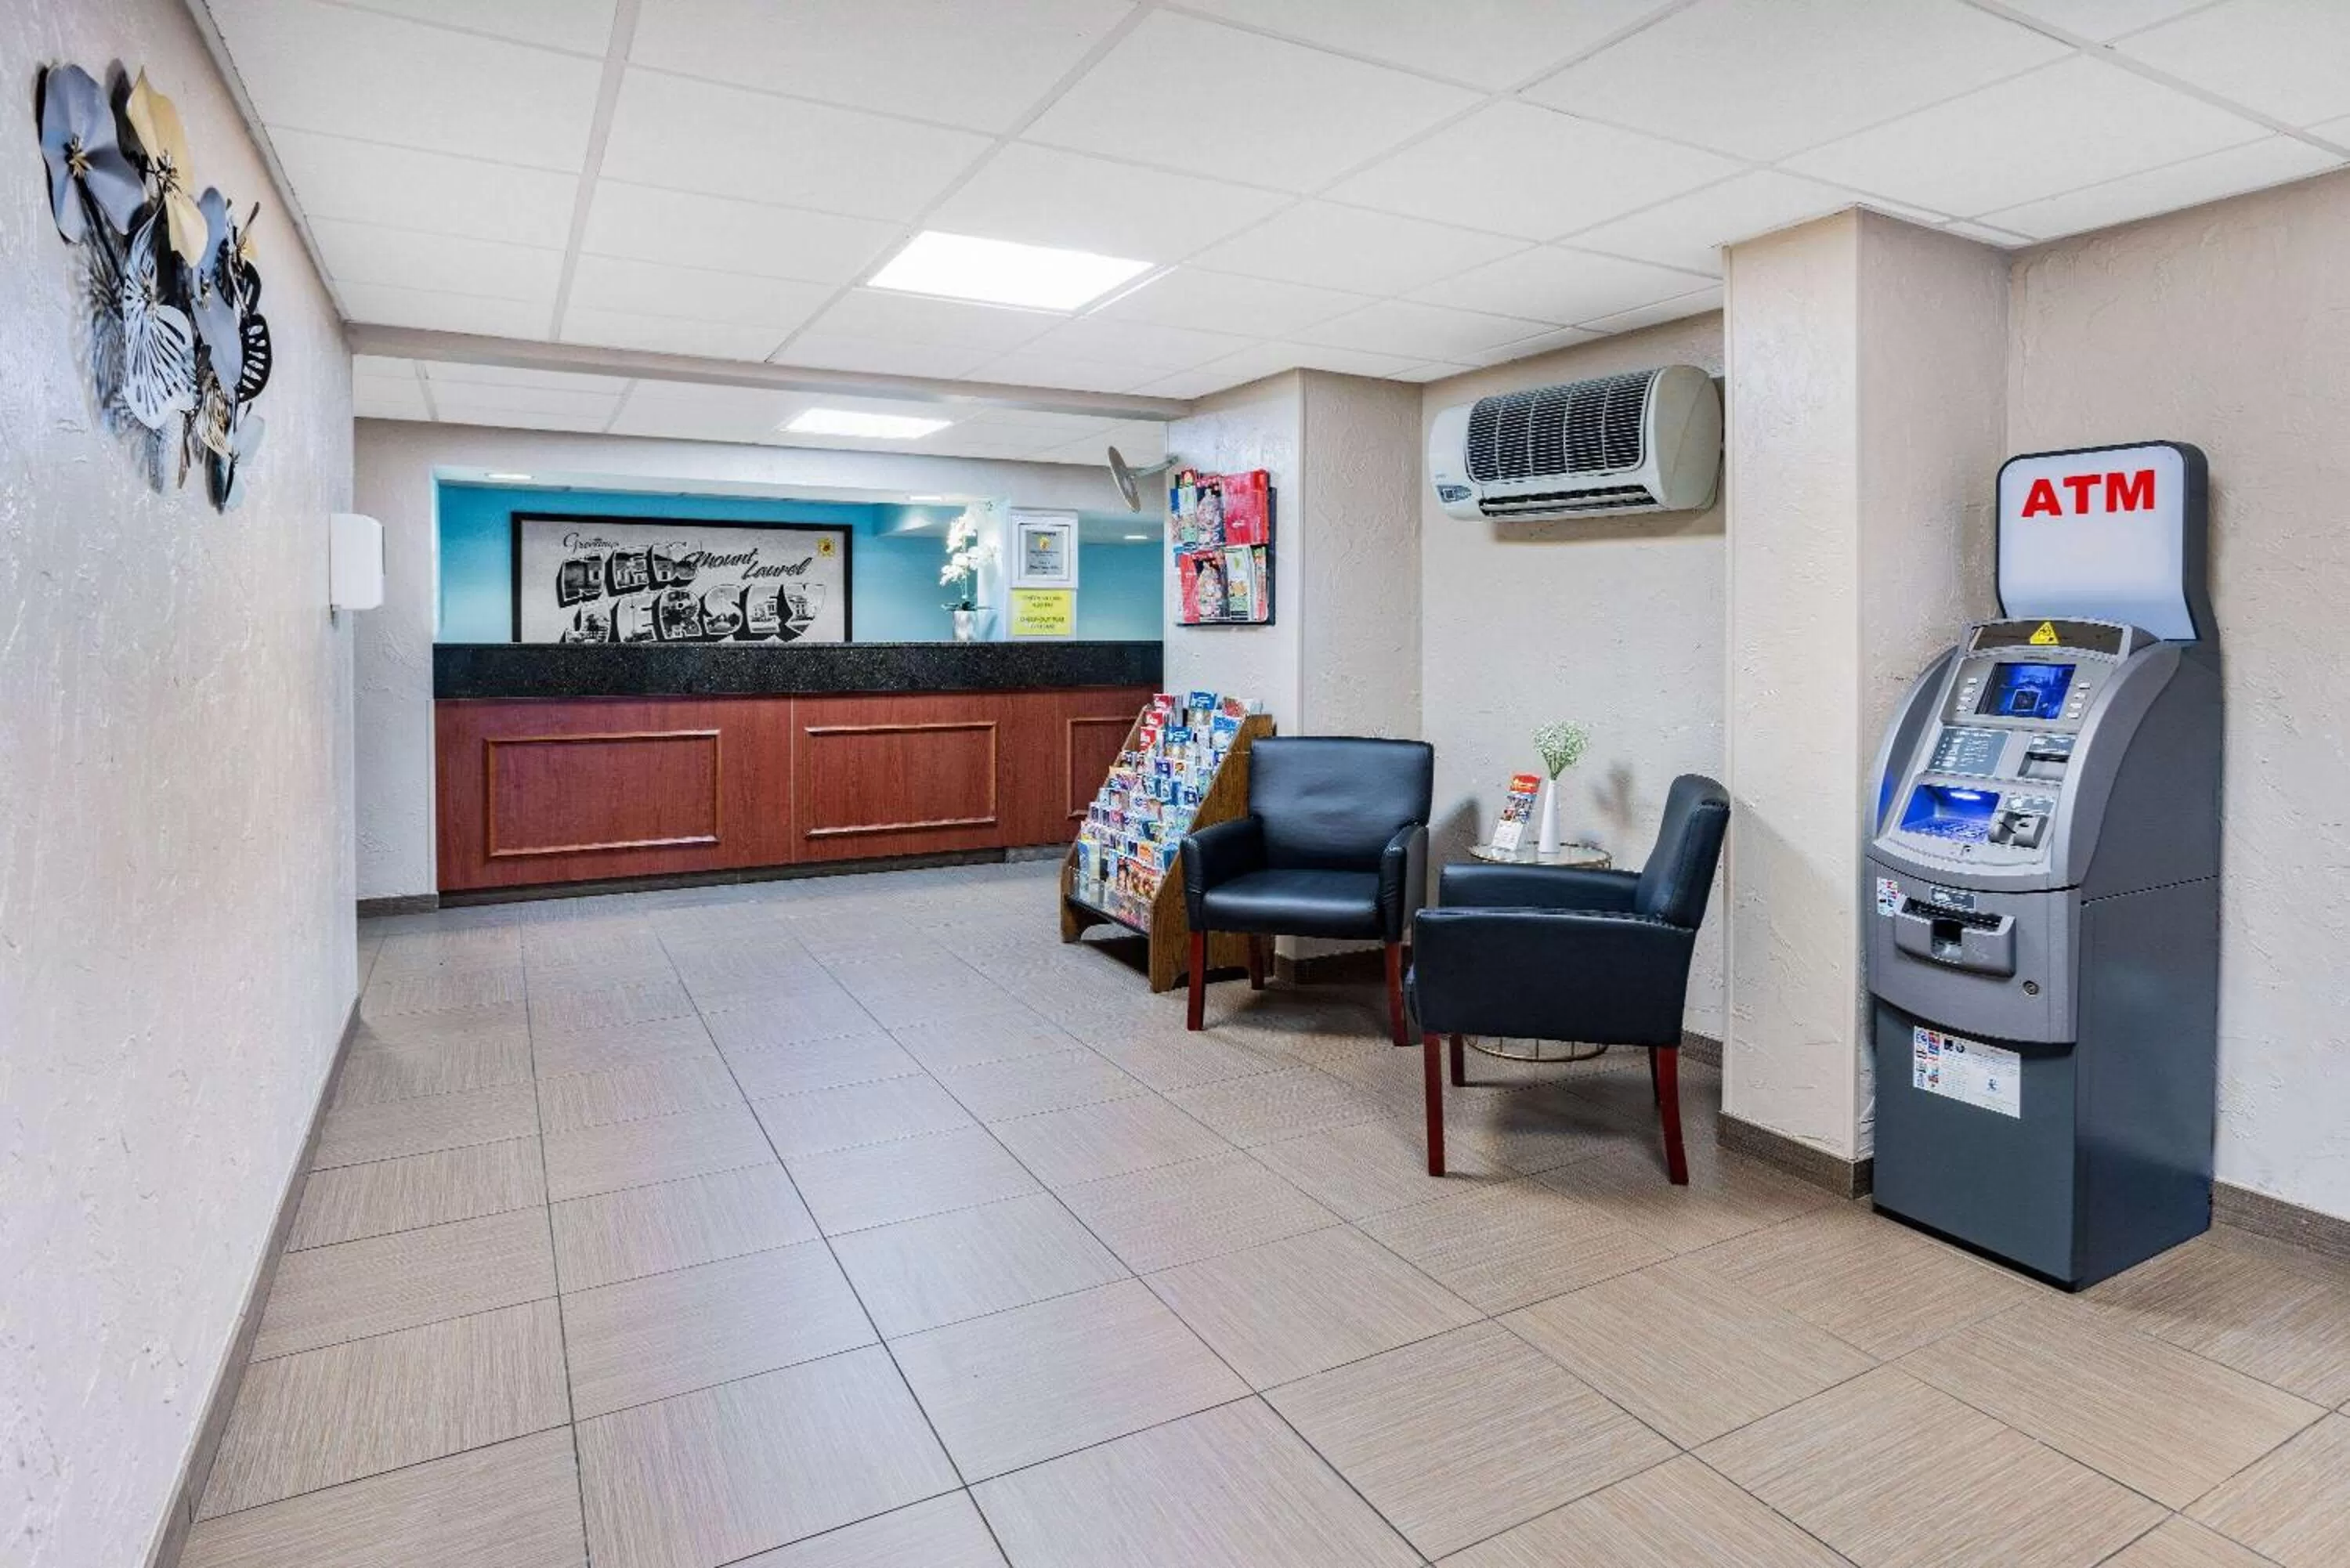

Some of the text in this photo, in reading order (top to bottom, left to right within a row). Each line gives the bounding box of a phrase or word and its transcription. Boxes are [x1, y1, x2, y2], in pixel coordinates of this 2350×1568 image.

[2021, 469, 2156, 518] ATM
[682, 547, 759, 569] Mount
[741, 557, 814, 580] Laurel
[559, 583, 826, 643] JERSEY
